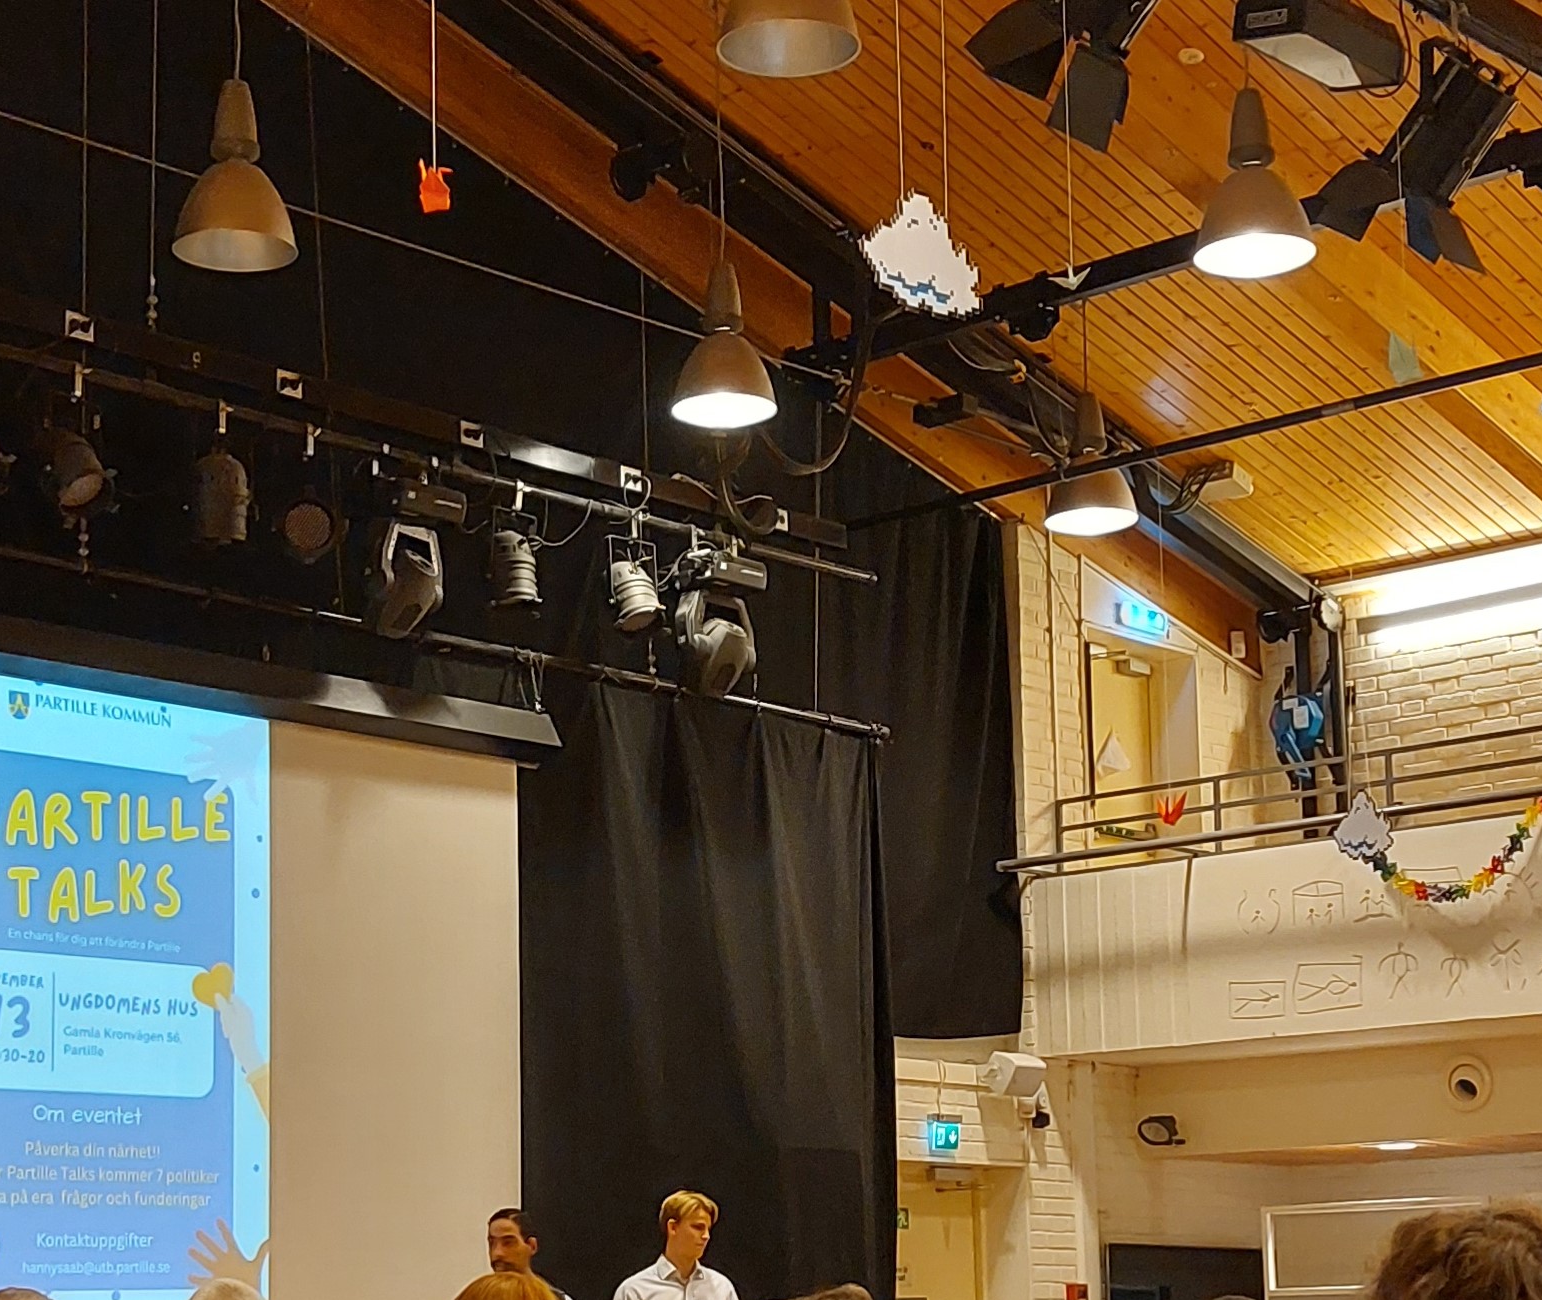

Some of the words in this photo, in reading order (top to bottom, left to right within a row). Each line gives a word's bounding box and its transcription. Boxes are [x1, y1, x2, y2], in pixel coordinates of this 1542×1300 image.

[35, 694, 98, 716] PARTILLE
[102, 704, 172, 728] KOMMUN
[7, 859, 181, 923] TALKS
[8, 928, 22, 939] En
[23, 929, 53, 942] chans
[55, 932, 69, 943] för
[71, 933, 87, 947] dig
[89, 936, 103, 946] att
[148, 939, 181, 953] Partille
[59, 992, 161, 1016] UNGDOMENS
[167, 999, 199, 1017] HUS
[63, 1025, 100, 1039] Gamla
[104, 1027, 164, 1043] Kronvägen
[63, 1043, 104, 1057] Partille
[33, 1104, 65, 1123] Om
[71, 1106, 142, 1125] eventet
[25, 1140, 79, 1157] Påverka
[83, 1143, 104, 1157] din
[7, 1165, 57, 1180] Partille
[61, 1165, 95, 1181] Talks
[99, 1167, 152, 1182] kommer
[156, 1168, 163, 1182] 7
[166, 1169, 219, 1186] politiker
[11, 1188, 27, 1207] på
[31, 1191, 54, 1205] era
[61, 1189, 103, 1209] frågor
[106, 1191, 131, 1205] och
[134, 1191, 211, 1210] funderingar
[36, 1232, 153, 1250] Kontaktuppgifter
